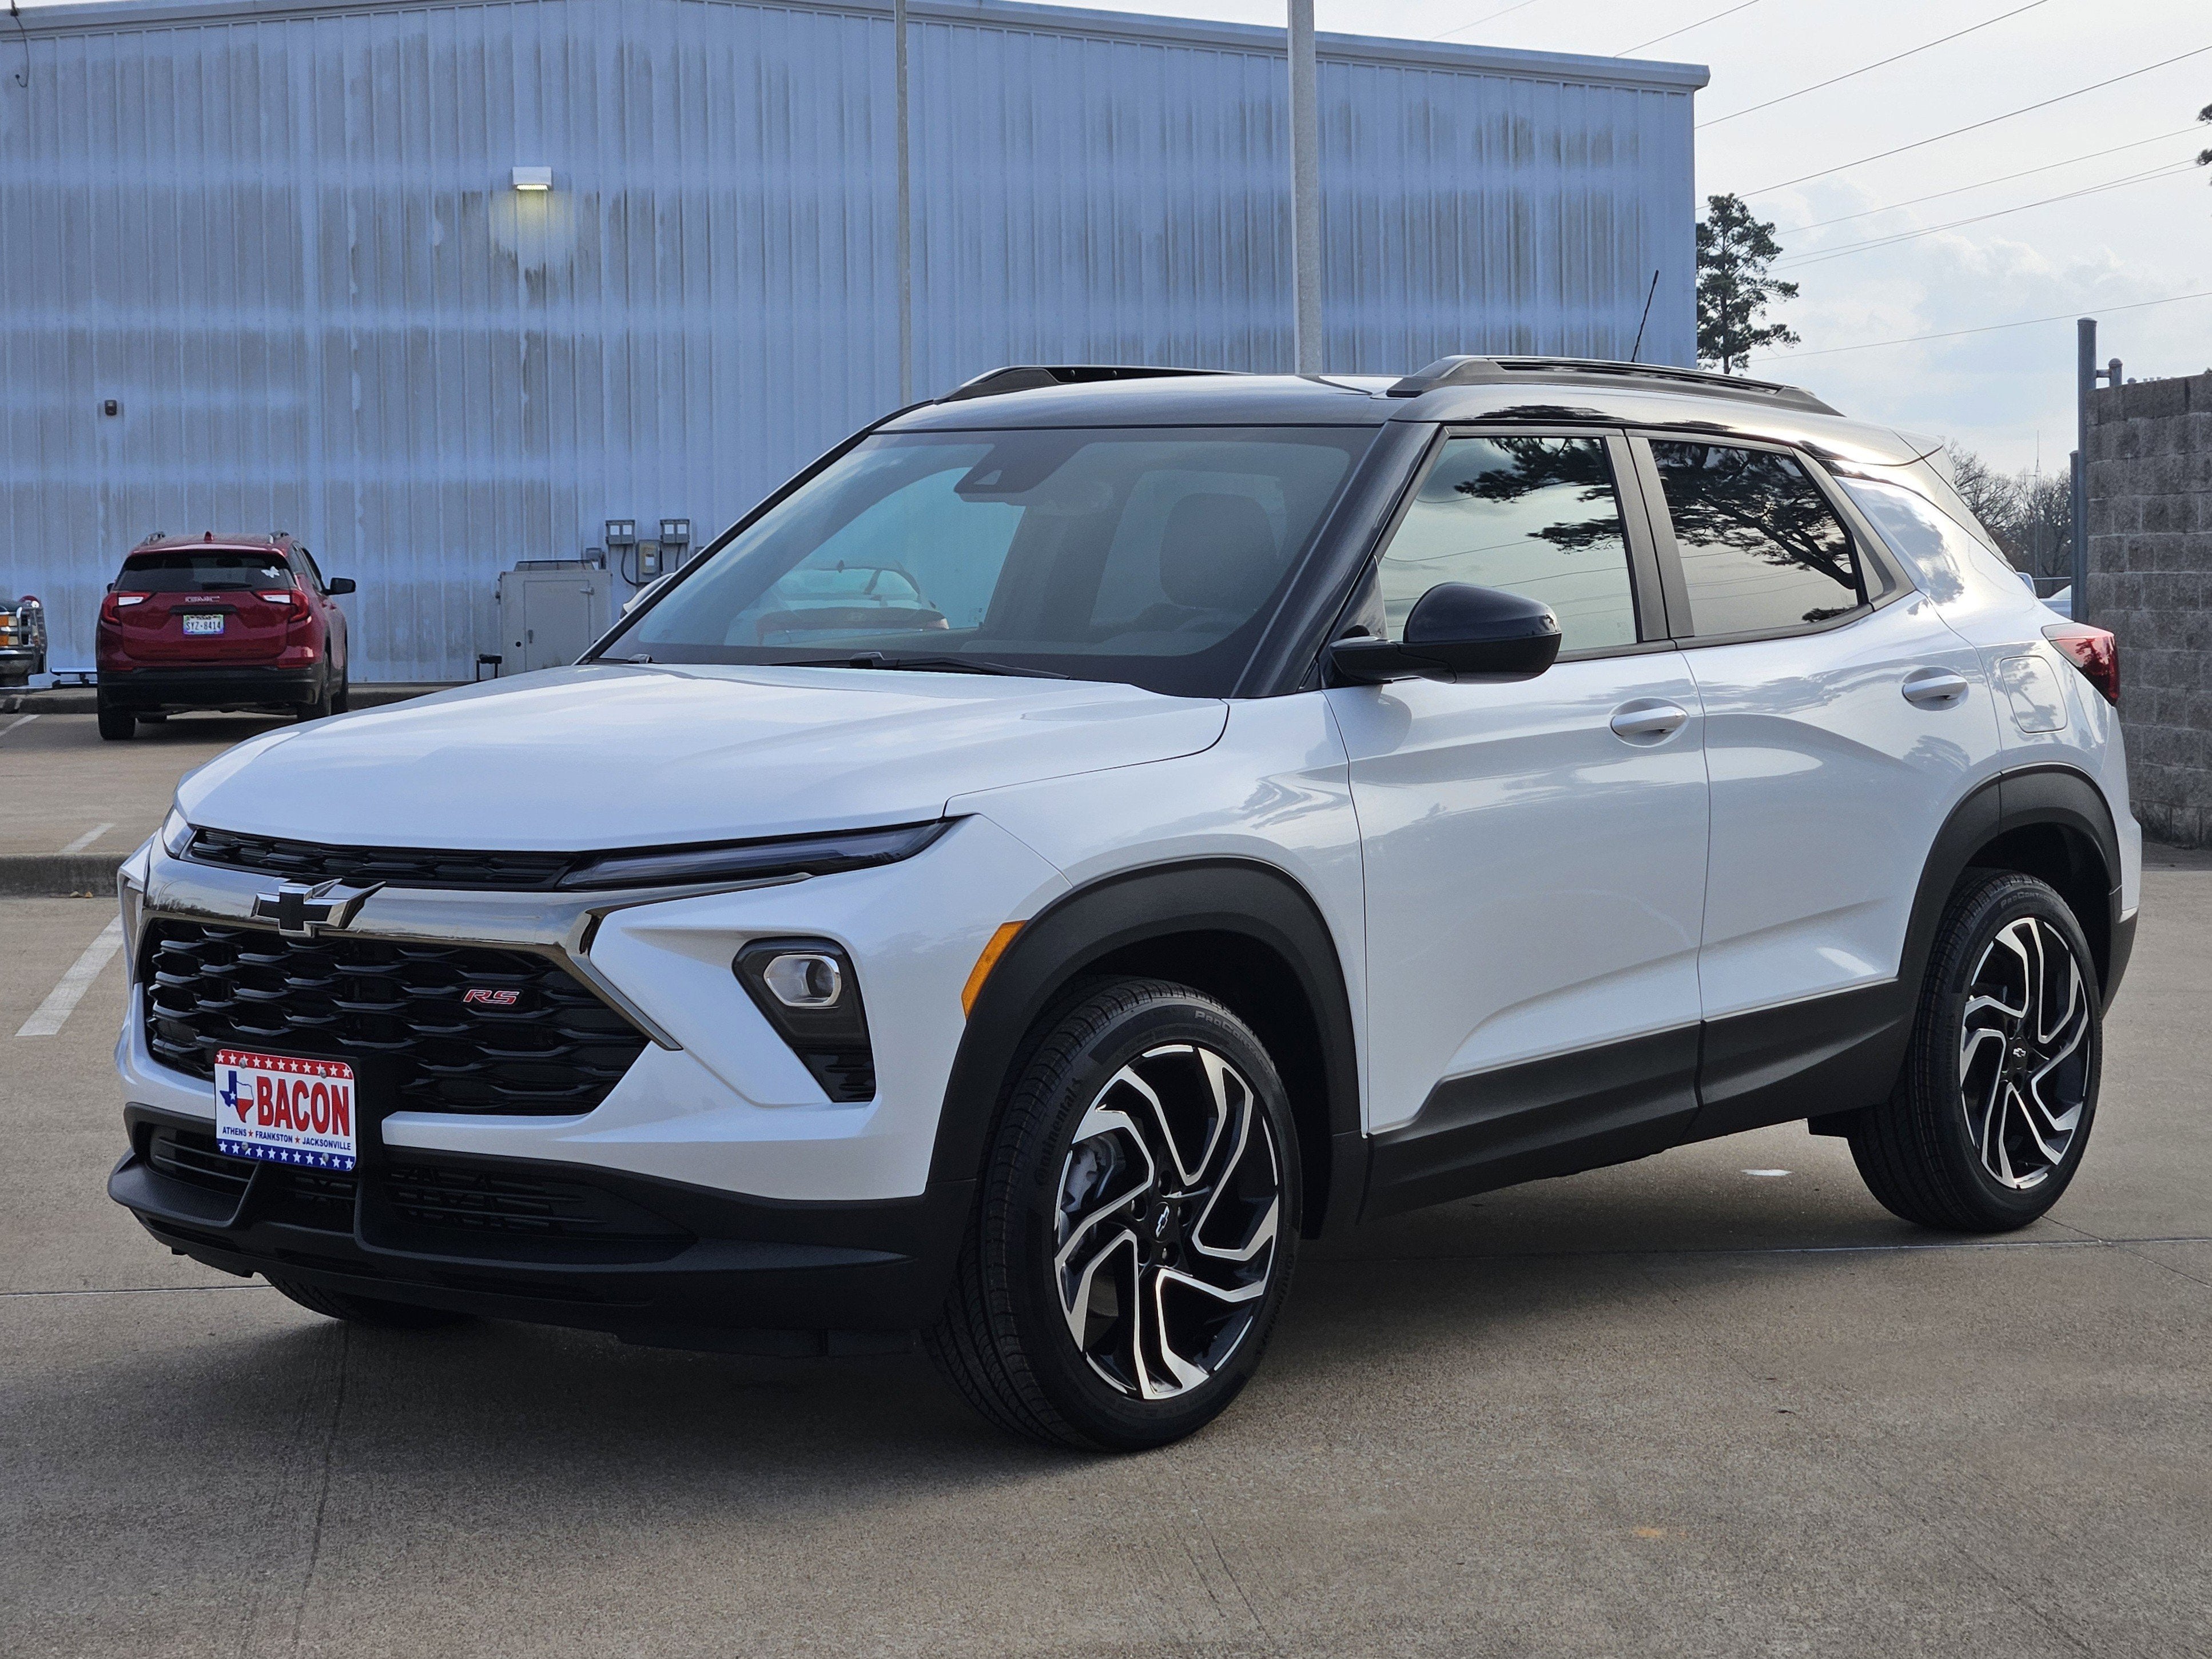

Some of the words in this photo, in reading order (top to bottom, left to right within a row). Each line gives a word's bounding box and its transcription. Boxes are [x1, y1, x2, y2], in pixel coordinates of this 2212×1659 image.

[463, 989, 519, 1004] RS
[257, 1076, 350, 1136] BACON
[222, 1127, 246, 1137] ATHENS
[255, 1131, 292, 1143] FRANKSTON
[303, 1137, 351, 1150] JACKSONVILLE
